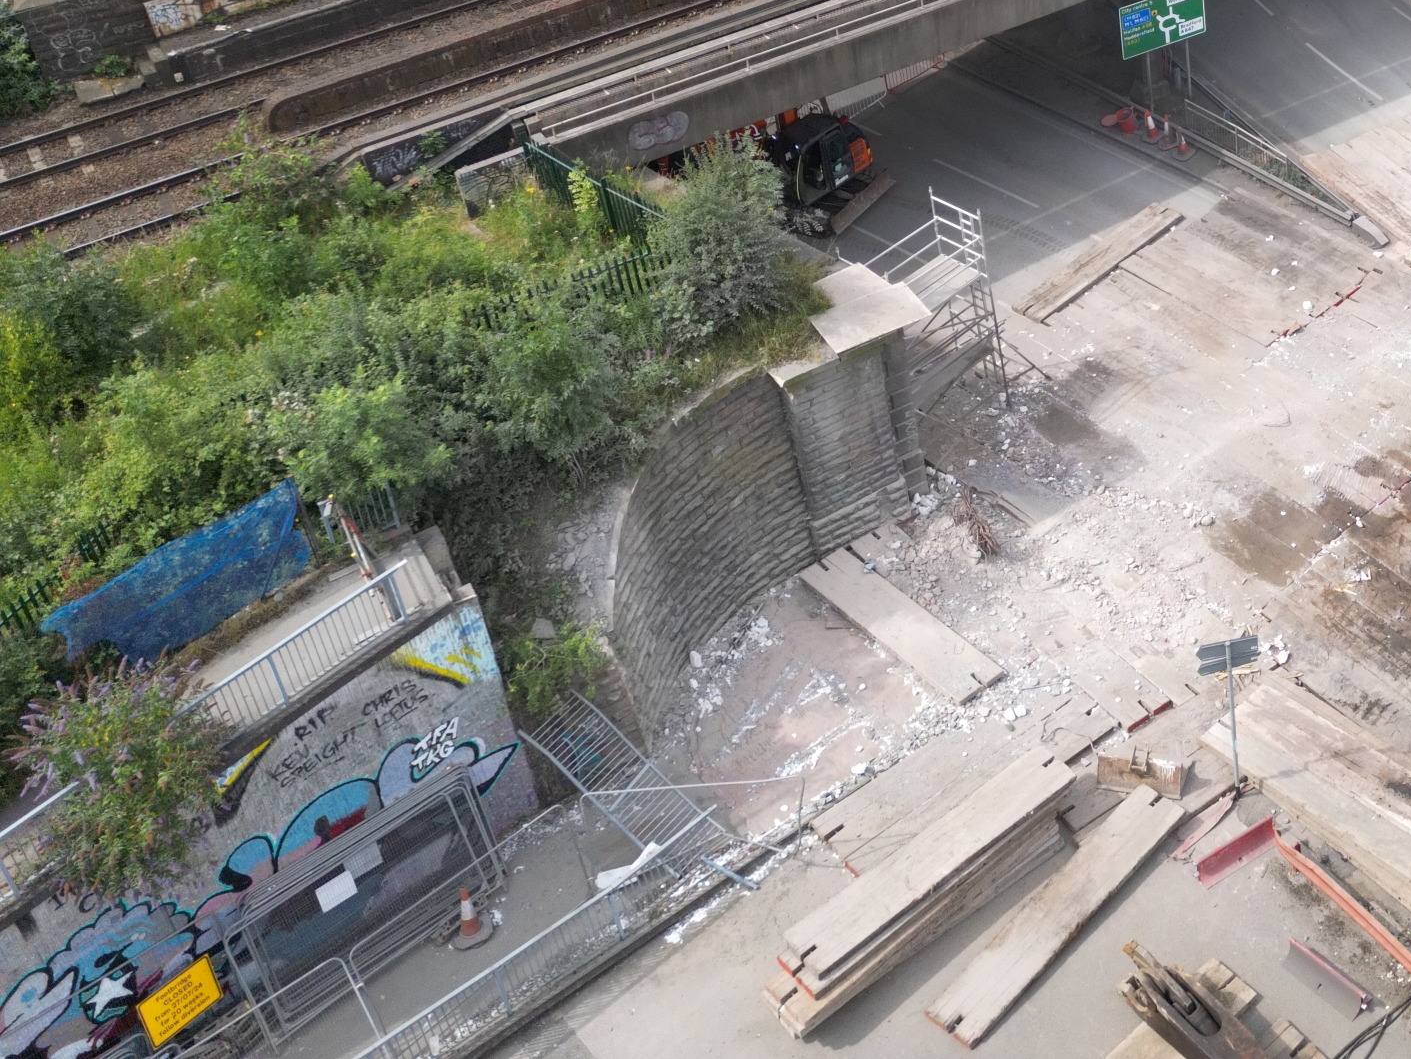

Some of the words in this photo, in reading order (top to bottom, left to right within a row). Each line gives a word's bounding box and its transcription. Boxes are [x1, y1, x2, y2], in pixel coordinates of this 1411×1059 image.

[1132, 3, 1148, 11] centre
[1180, 18, 1202, 29] Bradford
[1181, 26, 1194, 34] A647
[1123, 27, 1141, 35] Halifax
[1124, 27, 1155, 41] Huddersfield
[362, 679, 417, 716] CHRIS
[155, 974, 192, 1002] Footbridge
[163, 981, 193, 1006] CLOSED
[155, 1008, 171, 1022] from
[159, 1019, 180, 1037] follow
[181, 995, 211, 1020] diversion
[160, 1018, 170, 1026] for
[183, 992, 204, 1009] weeks
